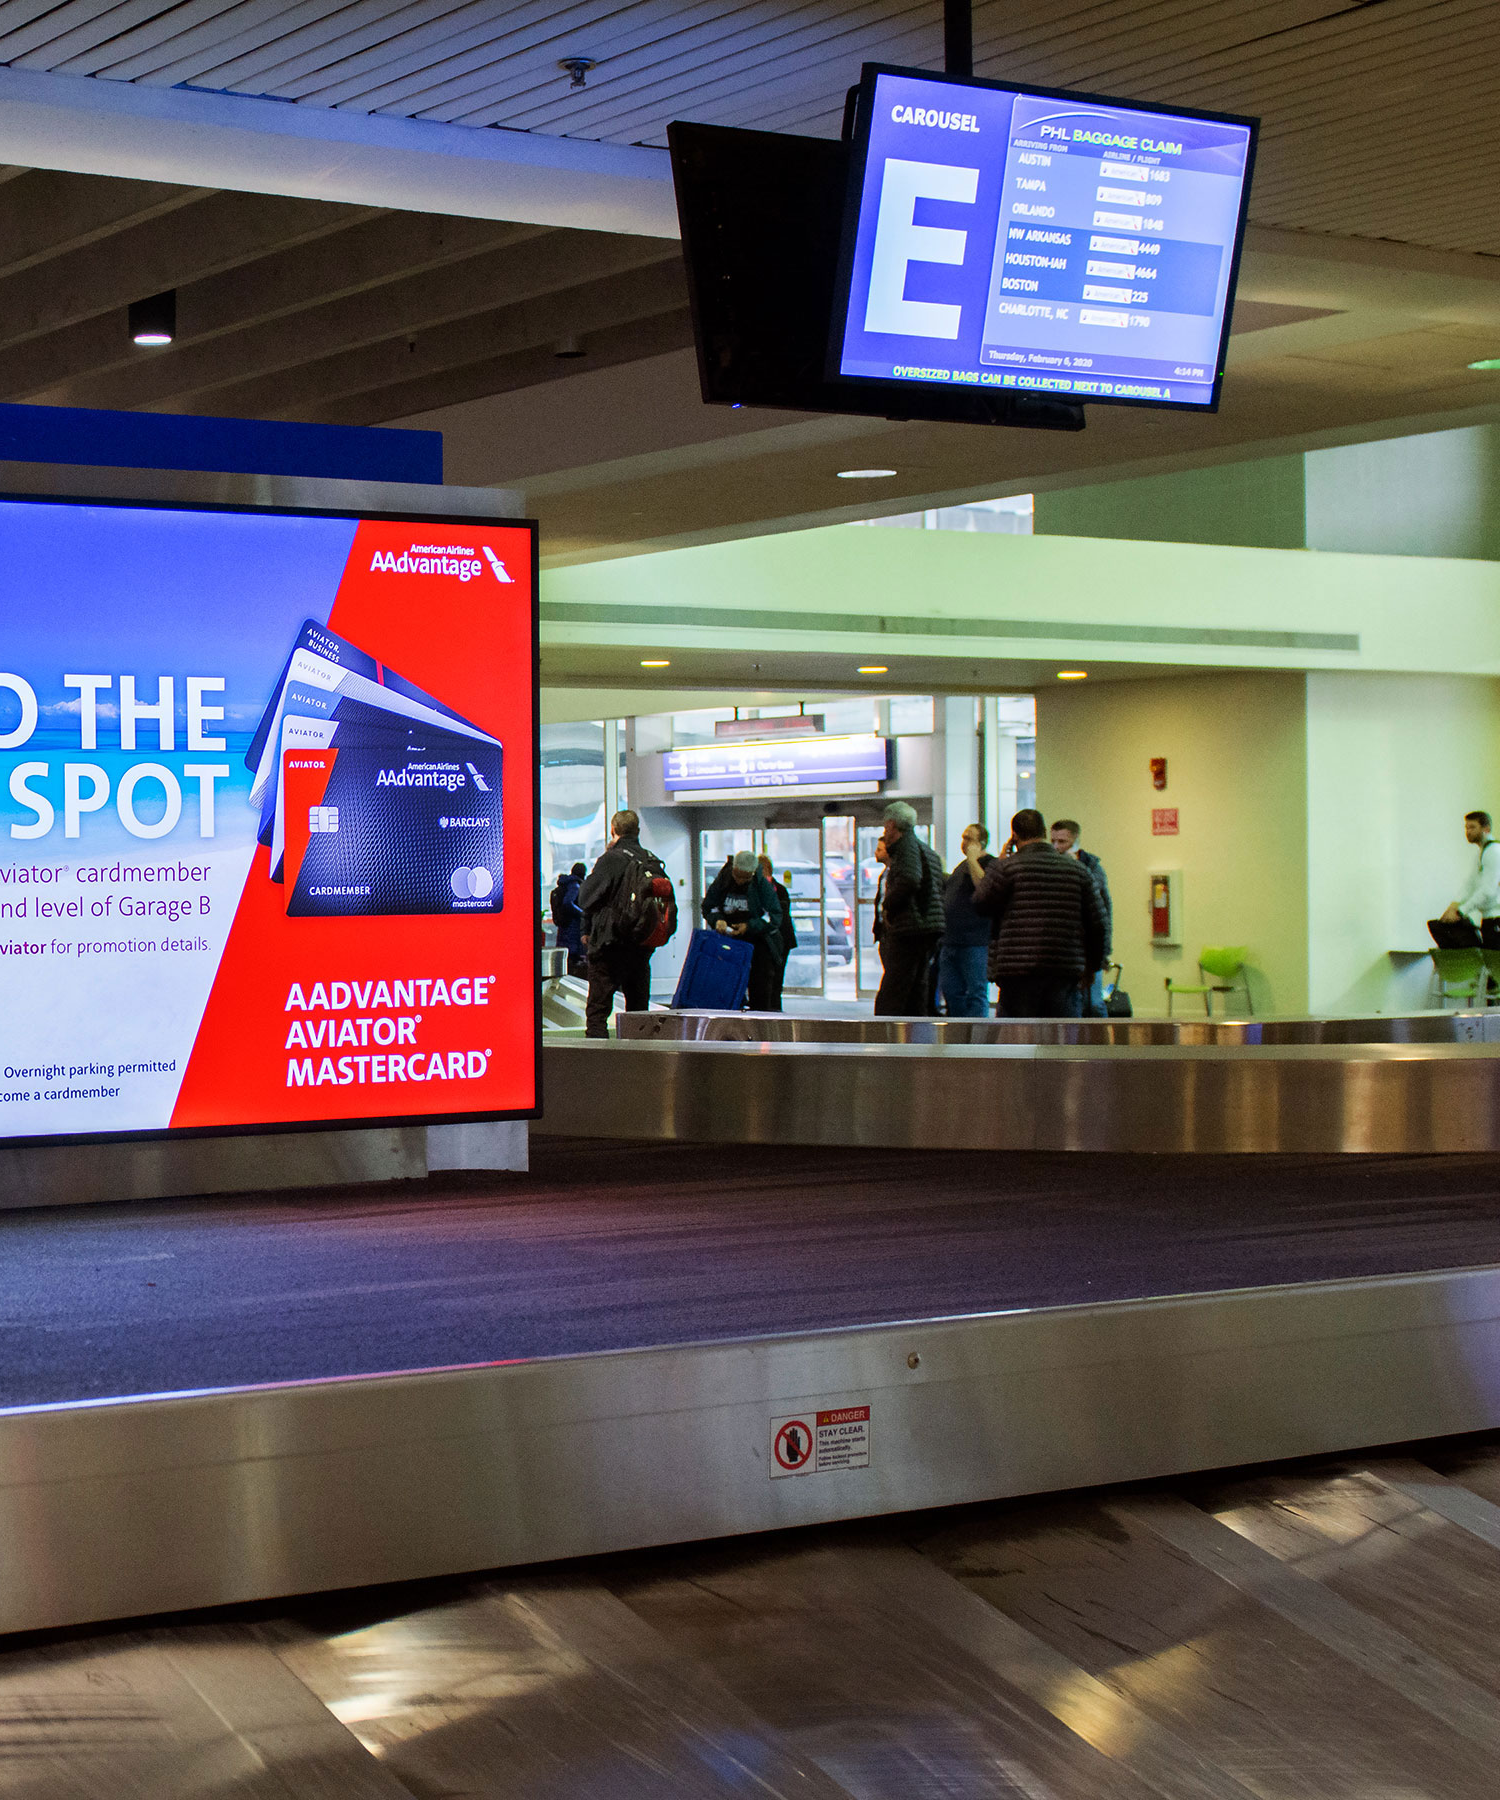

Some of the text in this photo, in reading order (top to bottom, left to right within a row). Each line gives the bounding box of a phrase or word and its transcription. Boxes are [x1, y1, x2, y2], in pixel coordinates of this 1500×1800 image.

[891, 105, 980, 132] CAROUSEL
[1041, 125, 1182, 155] PHL BAGGAGE CLAIM
[1049, 143, 1068, 152] FROM
[1018, 152, 1052, 167] AUSTIN
[1016, 177, 1046, 192] TAMPA
[1012, 202, 1055, 218] ORLANDO
[1009, 228, 1072, 245] NW ARKANSAS
[864, 158, 980, 340] E
[1005, 252, 1067, 270] HOUSTON-IAH
[1002, 277, 1039, 292] BOSTON
[1132, 291, 1148, 303] 225
[999, 302, 1069, 320] CHARLOTTE, NC
[988, 350, 1027, 363] Thursday,
[1028, 354, 1063, 366] February
[1073, 358, 1093, 368] 2020
[893, 366, 950, 380] OVERSIZED
[952, 371, 979, 383] BAGS
[980, 373, 1001, 385] CAN
[1002, 375, 1016, 386] BE
[1017, 376, 1071, 390] COLLECTED
[1073, 381, 1099, 392] NEXT
[1100, 383, 1113, 394] TO
[1114, 384, 1162, 398] CAROUSEL
[410, 544, 475, 556] American Airlines
[370, 551, 482, 582] AAdvantage
[307, 628, 340, 653] AVIATOR
[308, 639, 340, 663] BUSINESS
[297, 661, 332, 681] AVIATOR
[291, 693, 328, 710] AVIATOR
[64, 673, 227, 751] THE
[288, 728, 325, 739] AVIATOR
[288, 761, 326, 769] AVIATOR
[408, 762, 460, 771] American Airlines
[376, 769, 466, 792] AAdvantage
[9, 761, 230, 840] SPOT
[449, 818, 490, 828] BARCLAYS
[75, 862, 211, 883] cardmember
[309, 887, 371, 896] CARDMEMBER
[35, 896, 84, 918] level
[91, 896, 113, 917] of
[118, 896, 192, 922] Garage
[199, 896, 211, 915] B
[50, 939, 73, 954] for
[76, 939, 158, 957] promotion
[160, 936, 211, 952] details.
[4, 1064, 66, 1081] Overnight
[69, 1062, 115, 1080] parking
[117, 1060, 176, 1077] permitted
[33, 1091, 41, 1101] a
[43, 1086, 120, 1101] cardmember
[831, 1410, 865, 1422] DANGER
[819, 1428, 837, 1438] STAY
